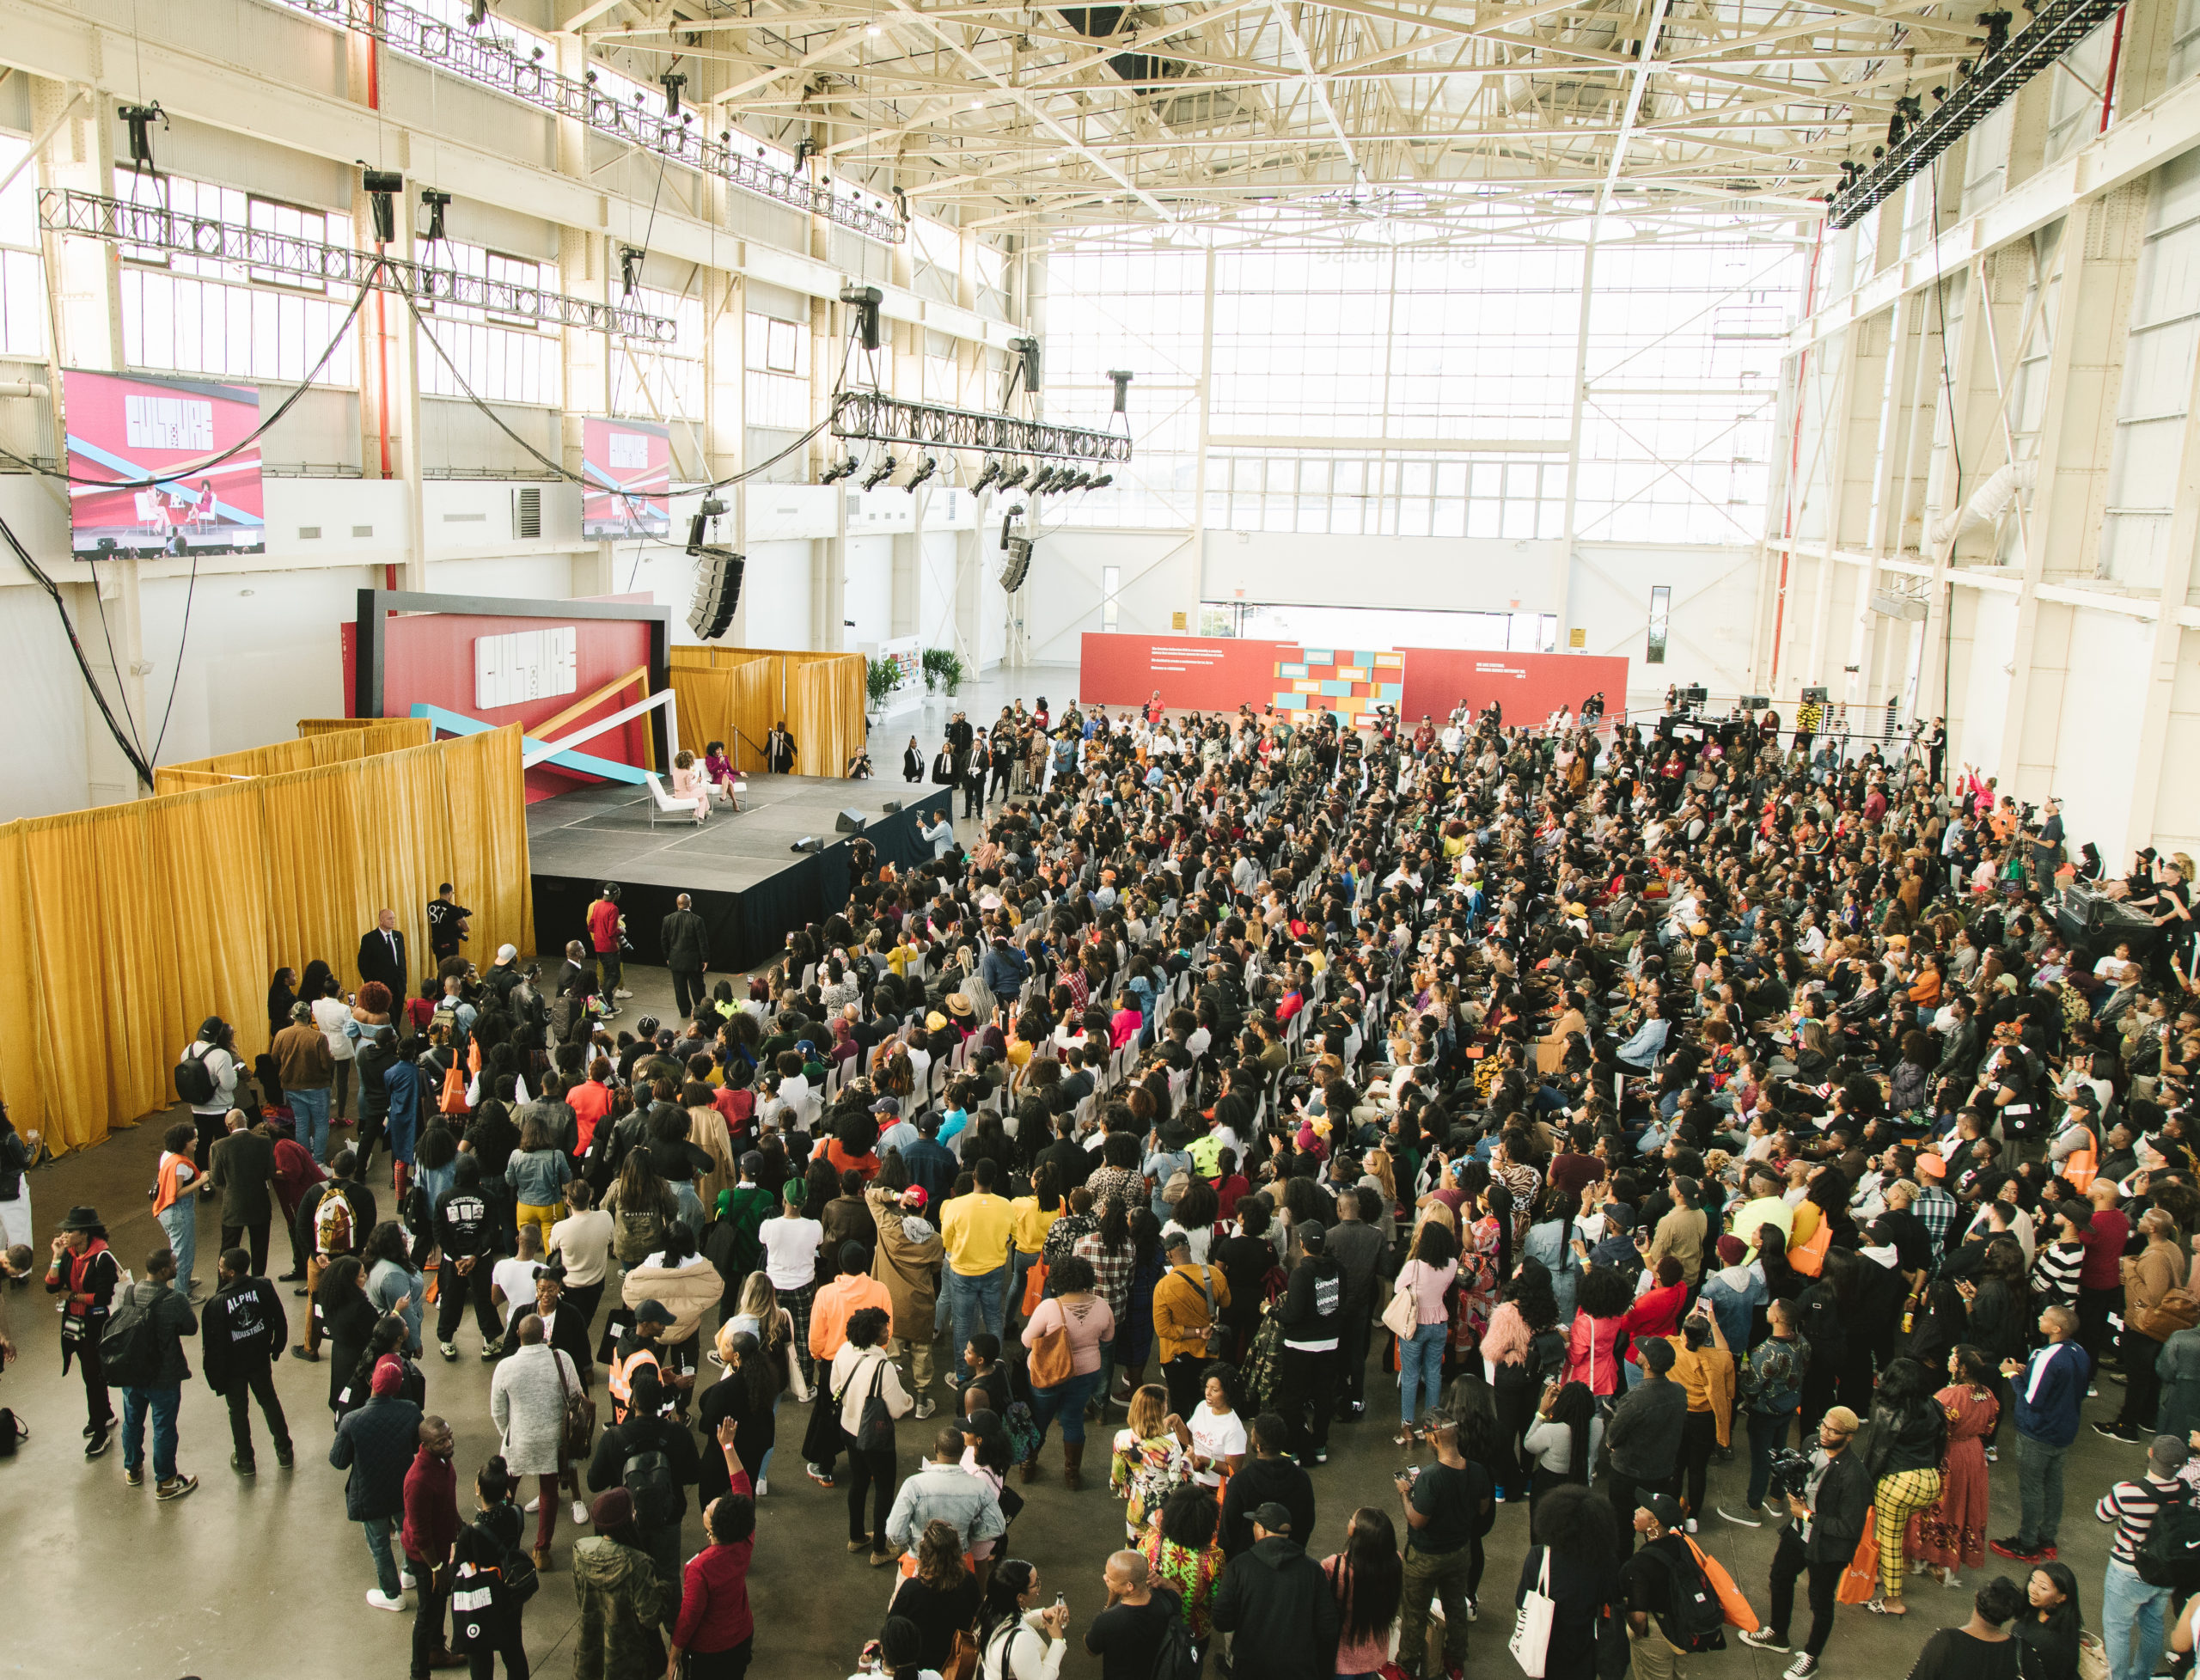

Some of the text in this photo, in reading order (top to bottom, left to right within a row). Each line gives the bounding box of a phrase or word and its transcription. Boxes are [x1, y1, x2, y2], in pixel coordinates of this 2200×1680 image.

[125, 394, 214, 451] CULTURE
[475, 626, 577, 710] CULTURE
[1315, 1277, 1339, 1290] CARBON
[227, 1290, 259, 1314] ALPHA
[1317, 1294, 1339, 1306] CARBON
[231, 1318, 265, 1341] INDUSTRIES
